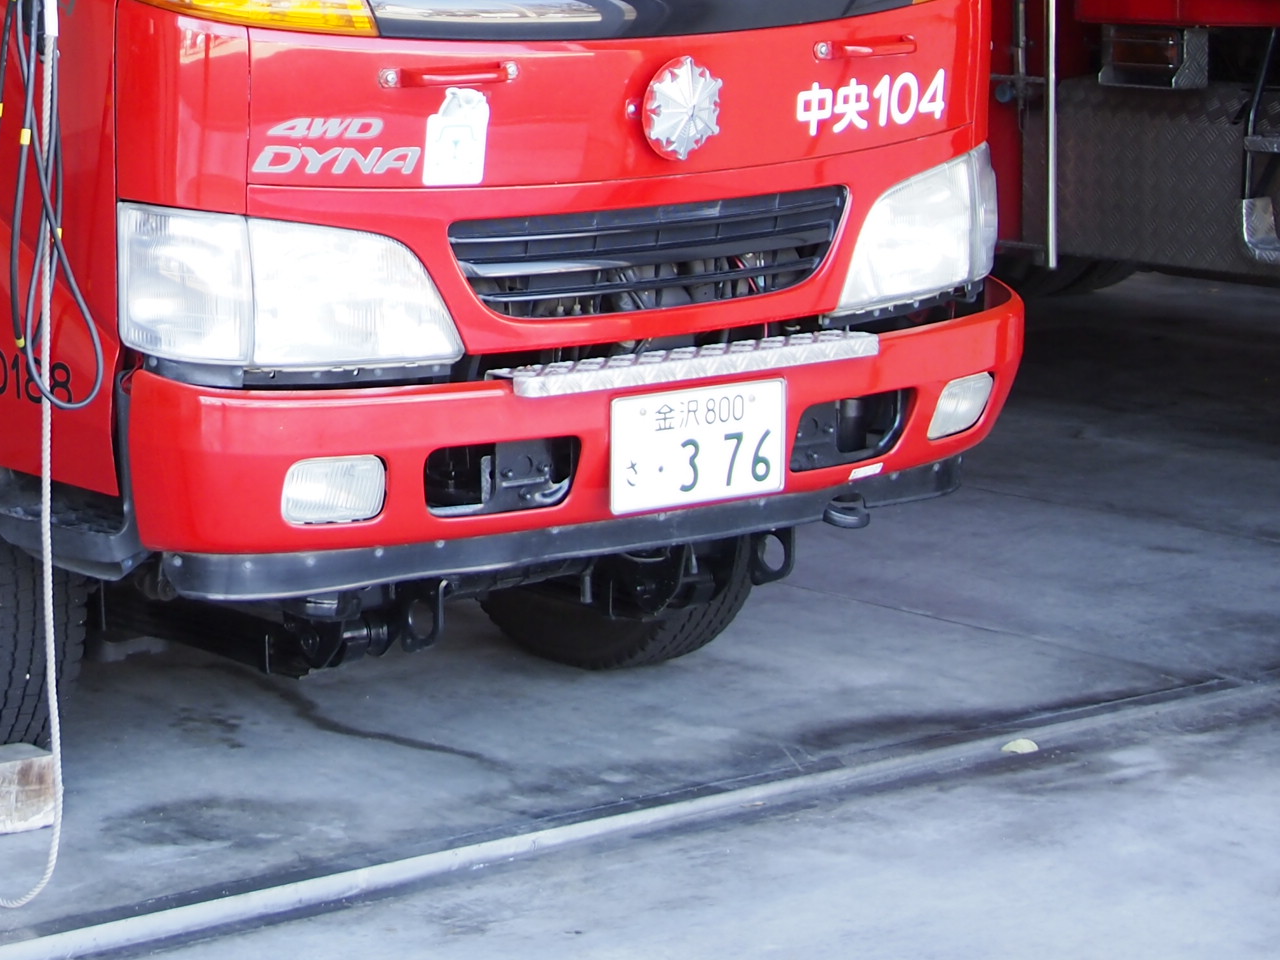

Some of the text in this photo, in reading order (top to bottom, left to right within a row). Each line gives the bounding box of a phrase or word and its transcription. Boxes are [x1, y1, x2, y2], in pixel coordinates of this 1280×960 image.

[796, 67, 946, 137] 中央104
[266, 117, 385, 139] 4WD
[251, 145, 421, 174] DYNA
